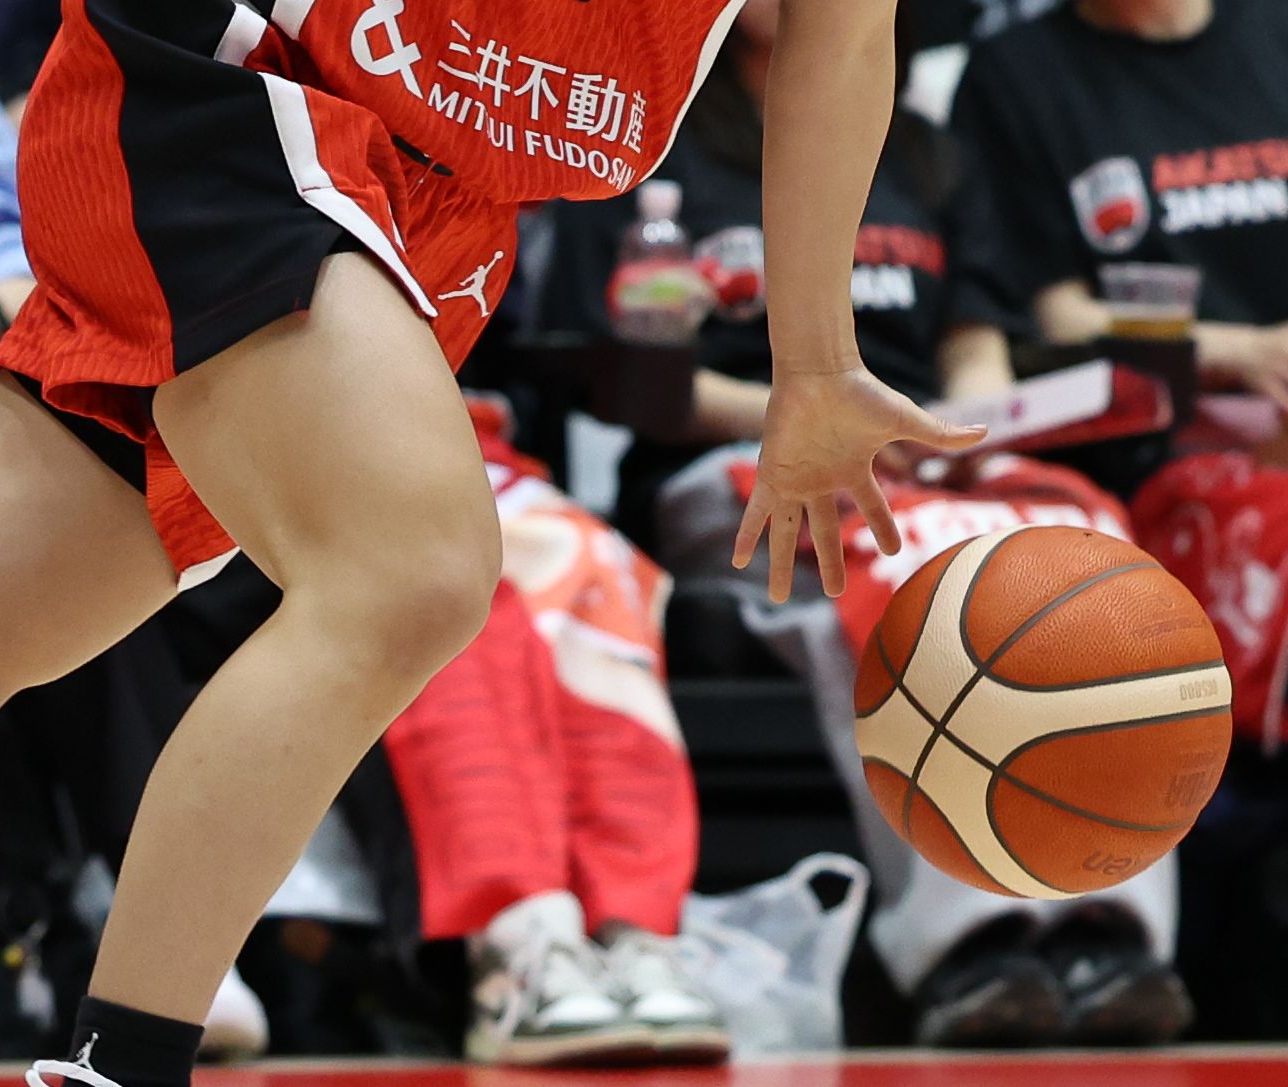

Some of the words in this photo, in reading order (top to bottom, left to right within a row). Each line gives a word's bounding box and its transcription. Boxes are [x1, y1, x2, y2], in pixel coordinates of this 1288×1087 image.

[426, 82, 515, 152] MITUI
[524, 129, 637, 194] FUDOSAN
[437, 18, 648, 154] 三井不動産
